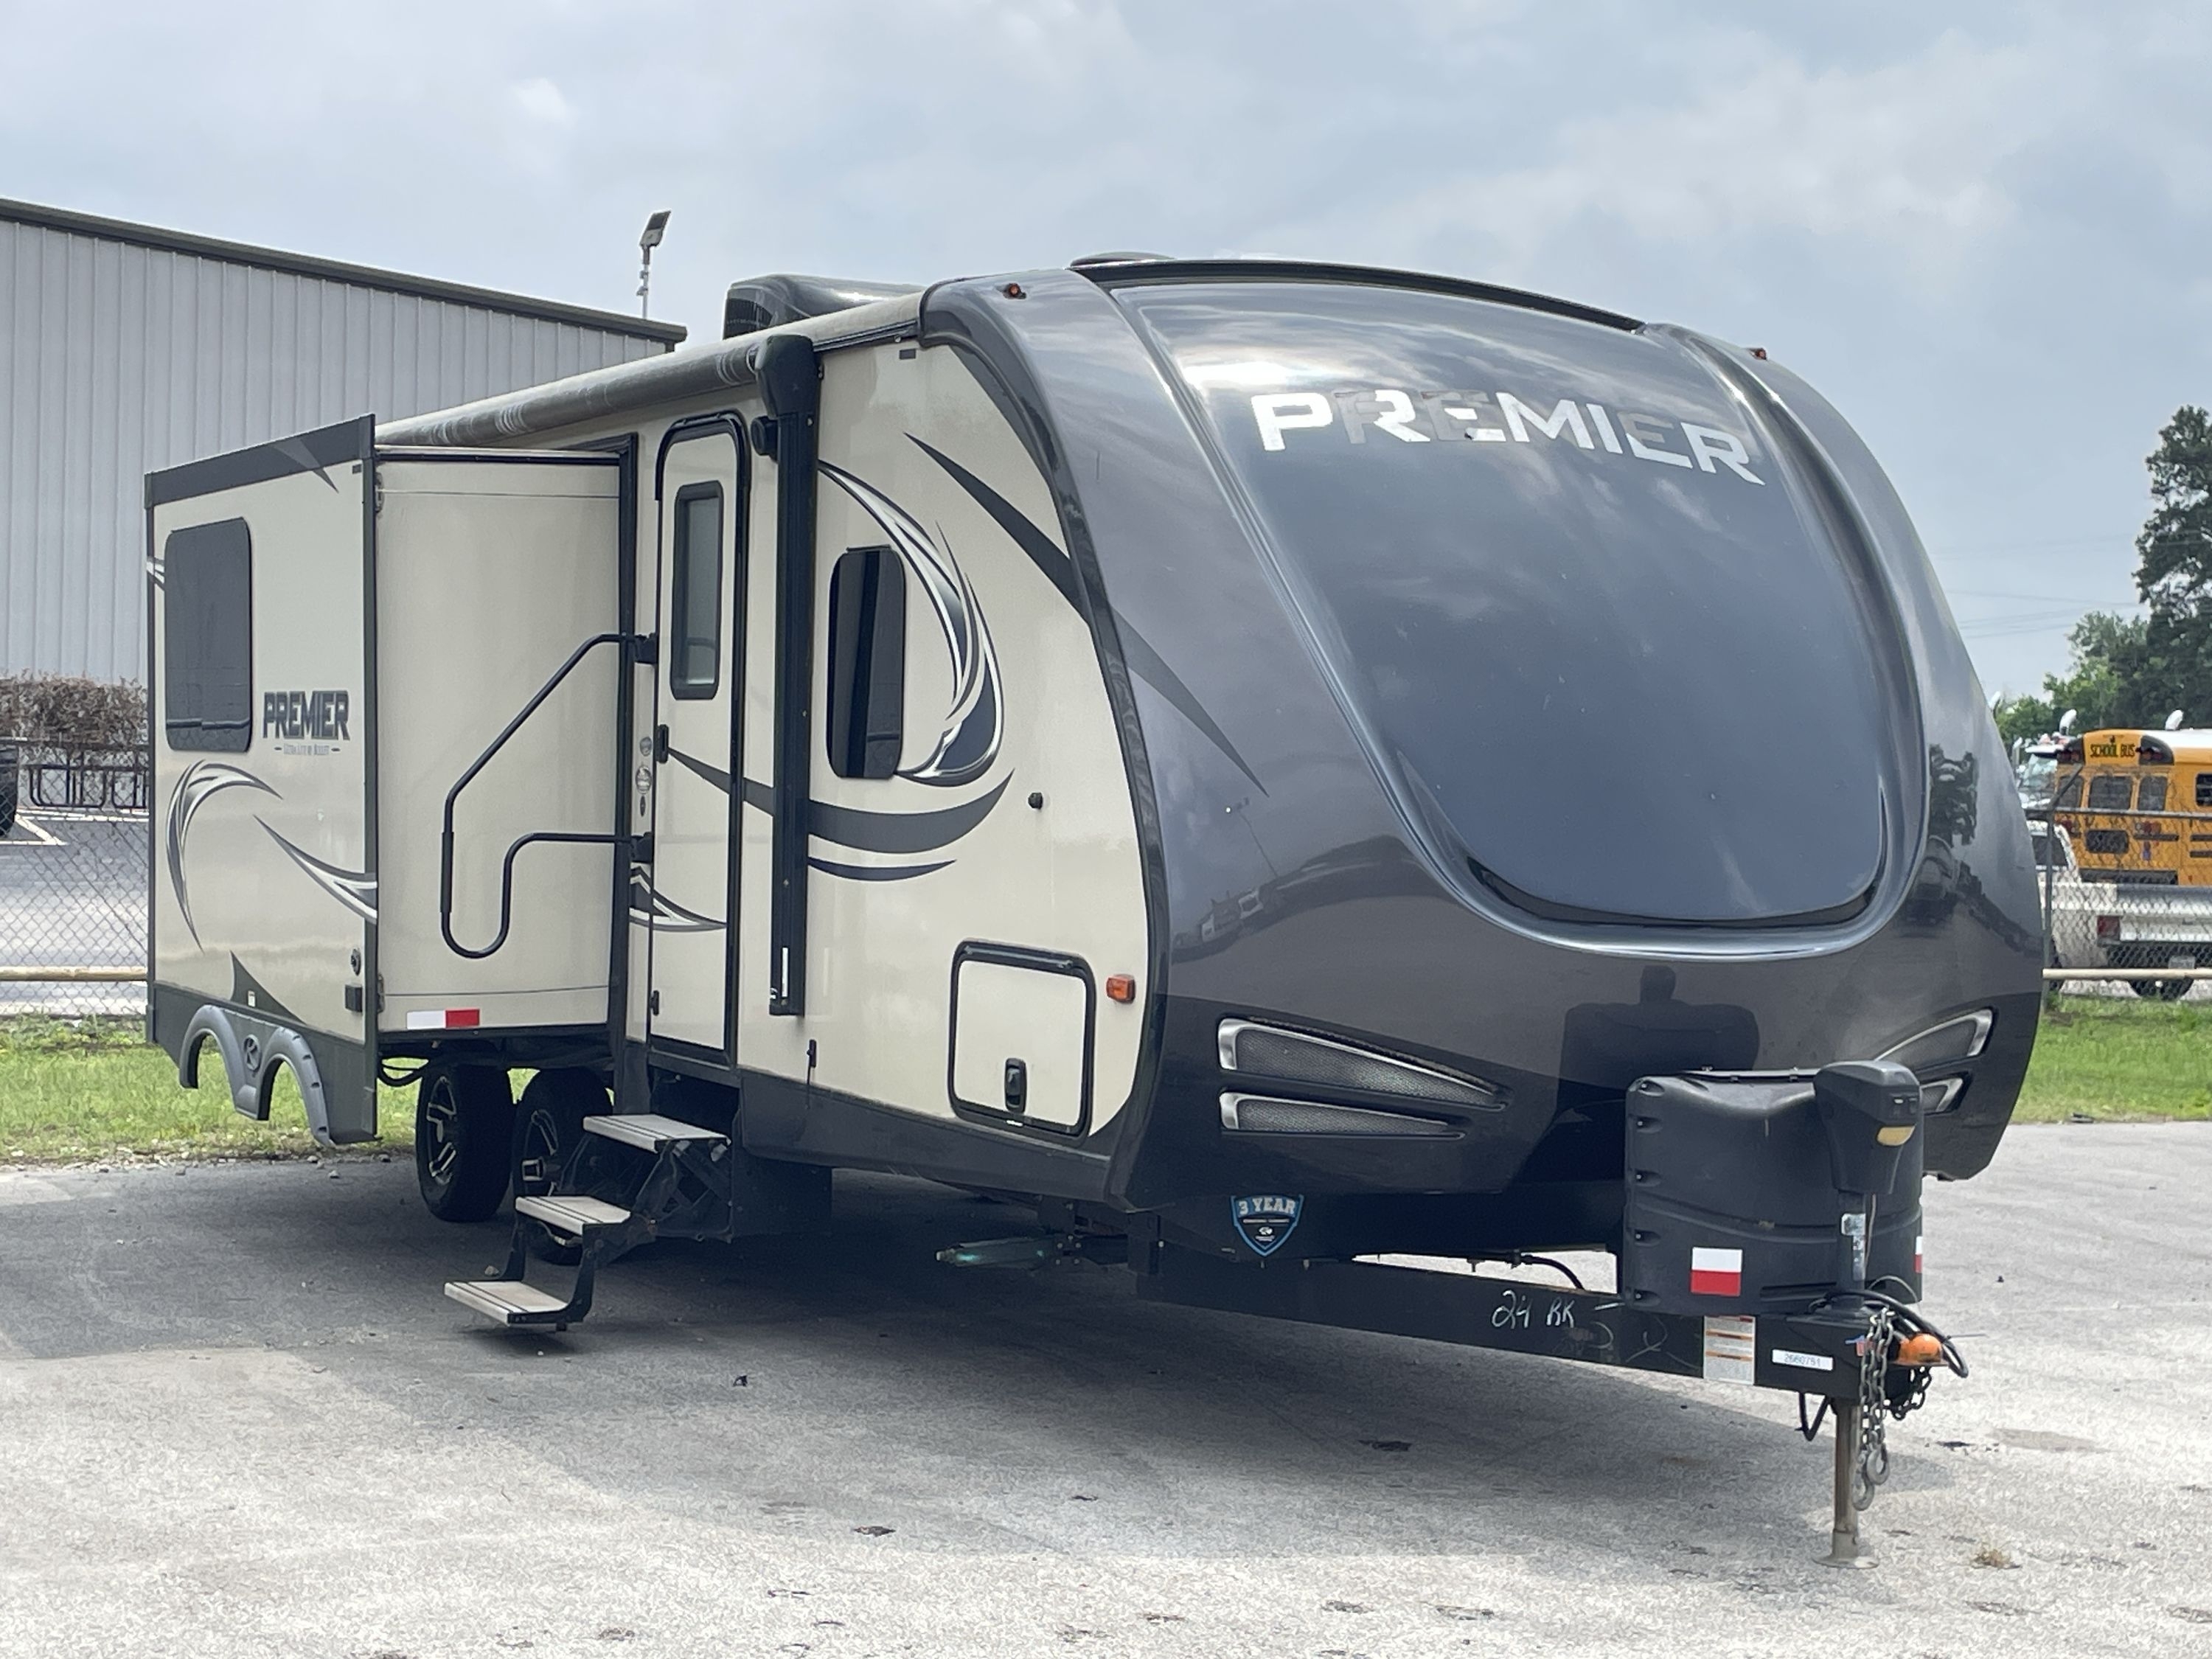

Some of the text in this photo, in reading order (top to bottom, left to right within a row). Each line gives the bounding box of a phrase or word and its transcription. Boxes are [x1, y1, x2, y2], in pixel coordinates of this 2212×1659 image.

[1251, 389, 1765, 485] PREMIER
[263, 690, 350, 740] PREMIER
[2090, 743, 2135, 758] SCHOOL BUS
[1239, 1197, 1296, 1215] 3 YEAR
